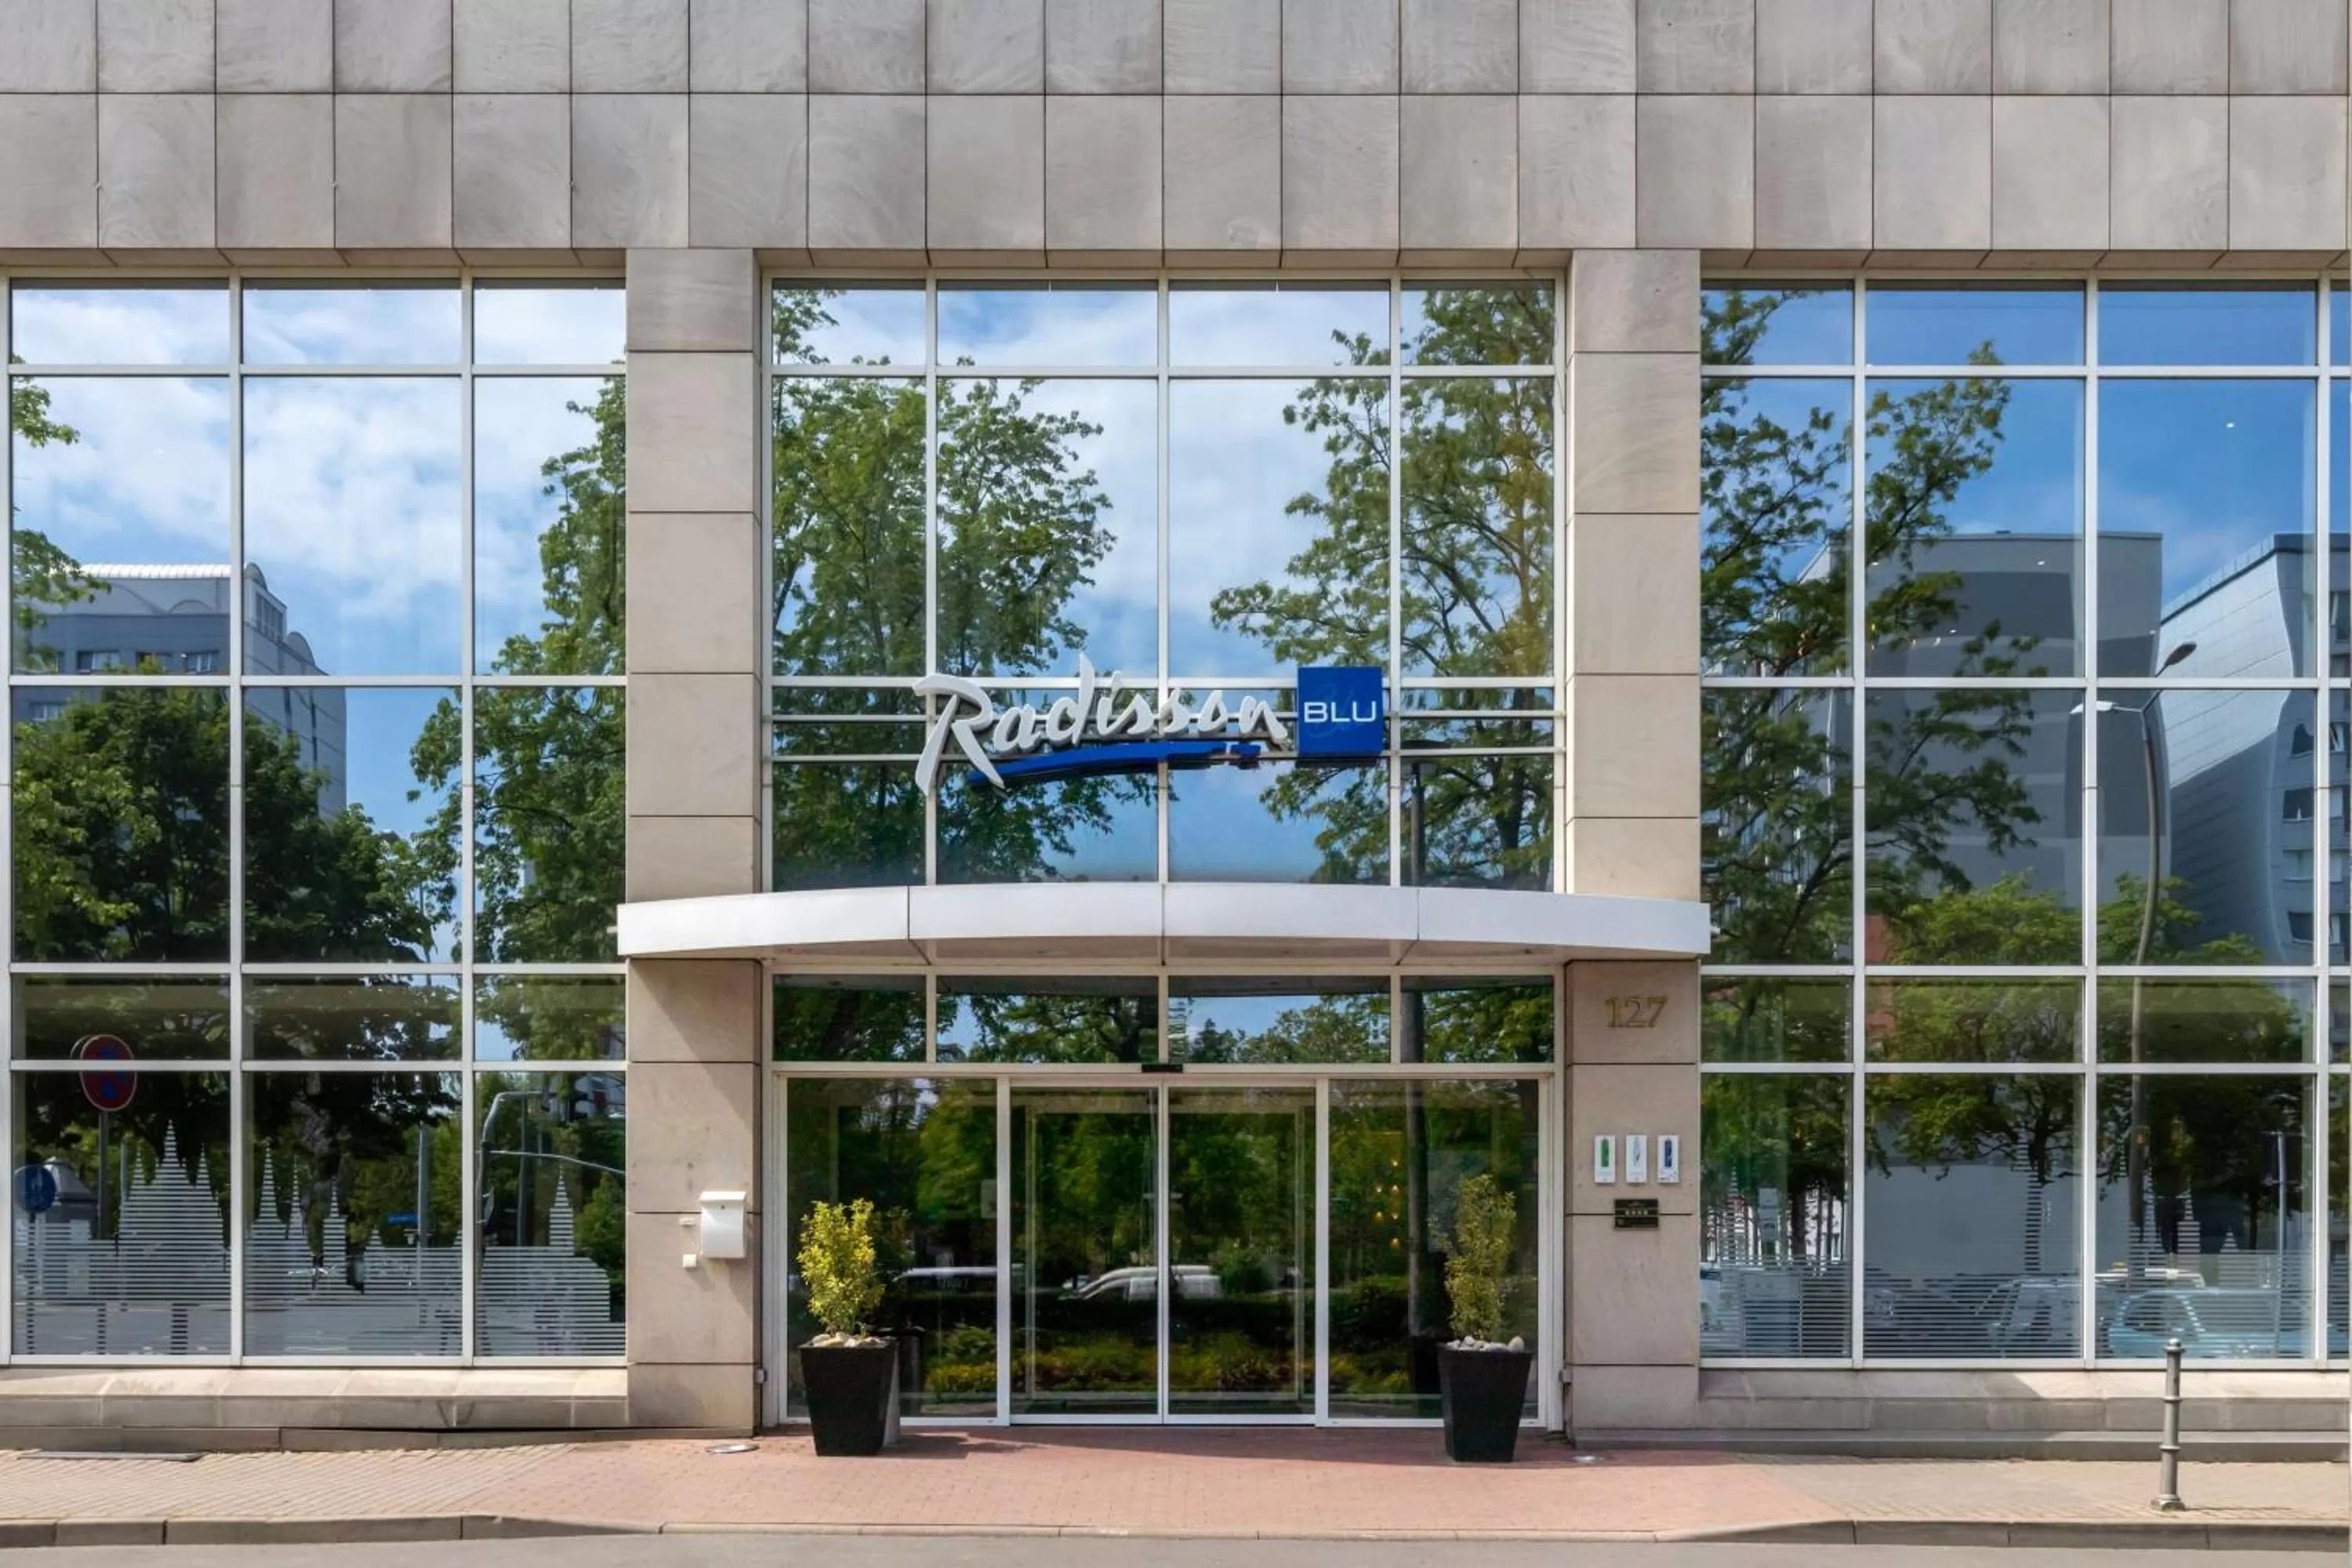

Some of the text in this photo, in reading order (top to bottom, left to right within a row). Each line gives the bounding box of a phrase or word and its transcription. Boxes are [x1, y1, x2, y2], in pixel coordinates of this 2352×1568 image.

[913, 652, 1377, 796] Radisson BLU
[1605, 996, 1669, 1029] 127
